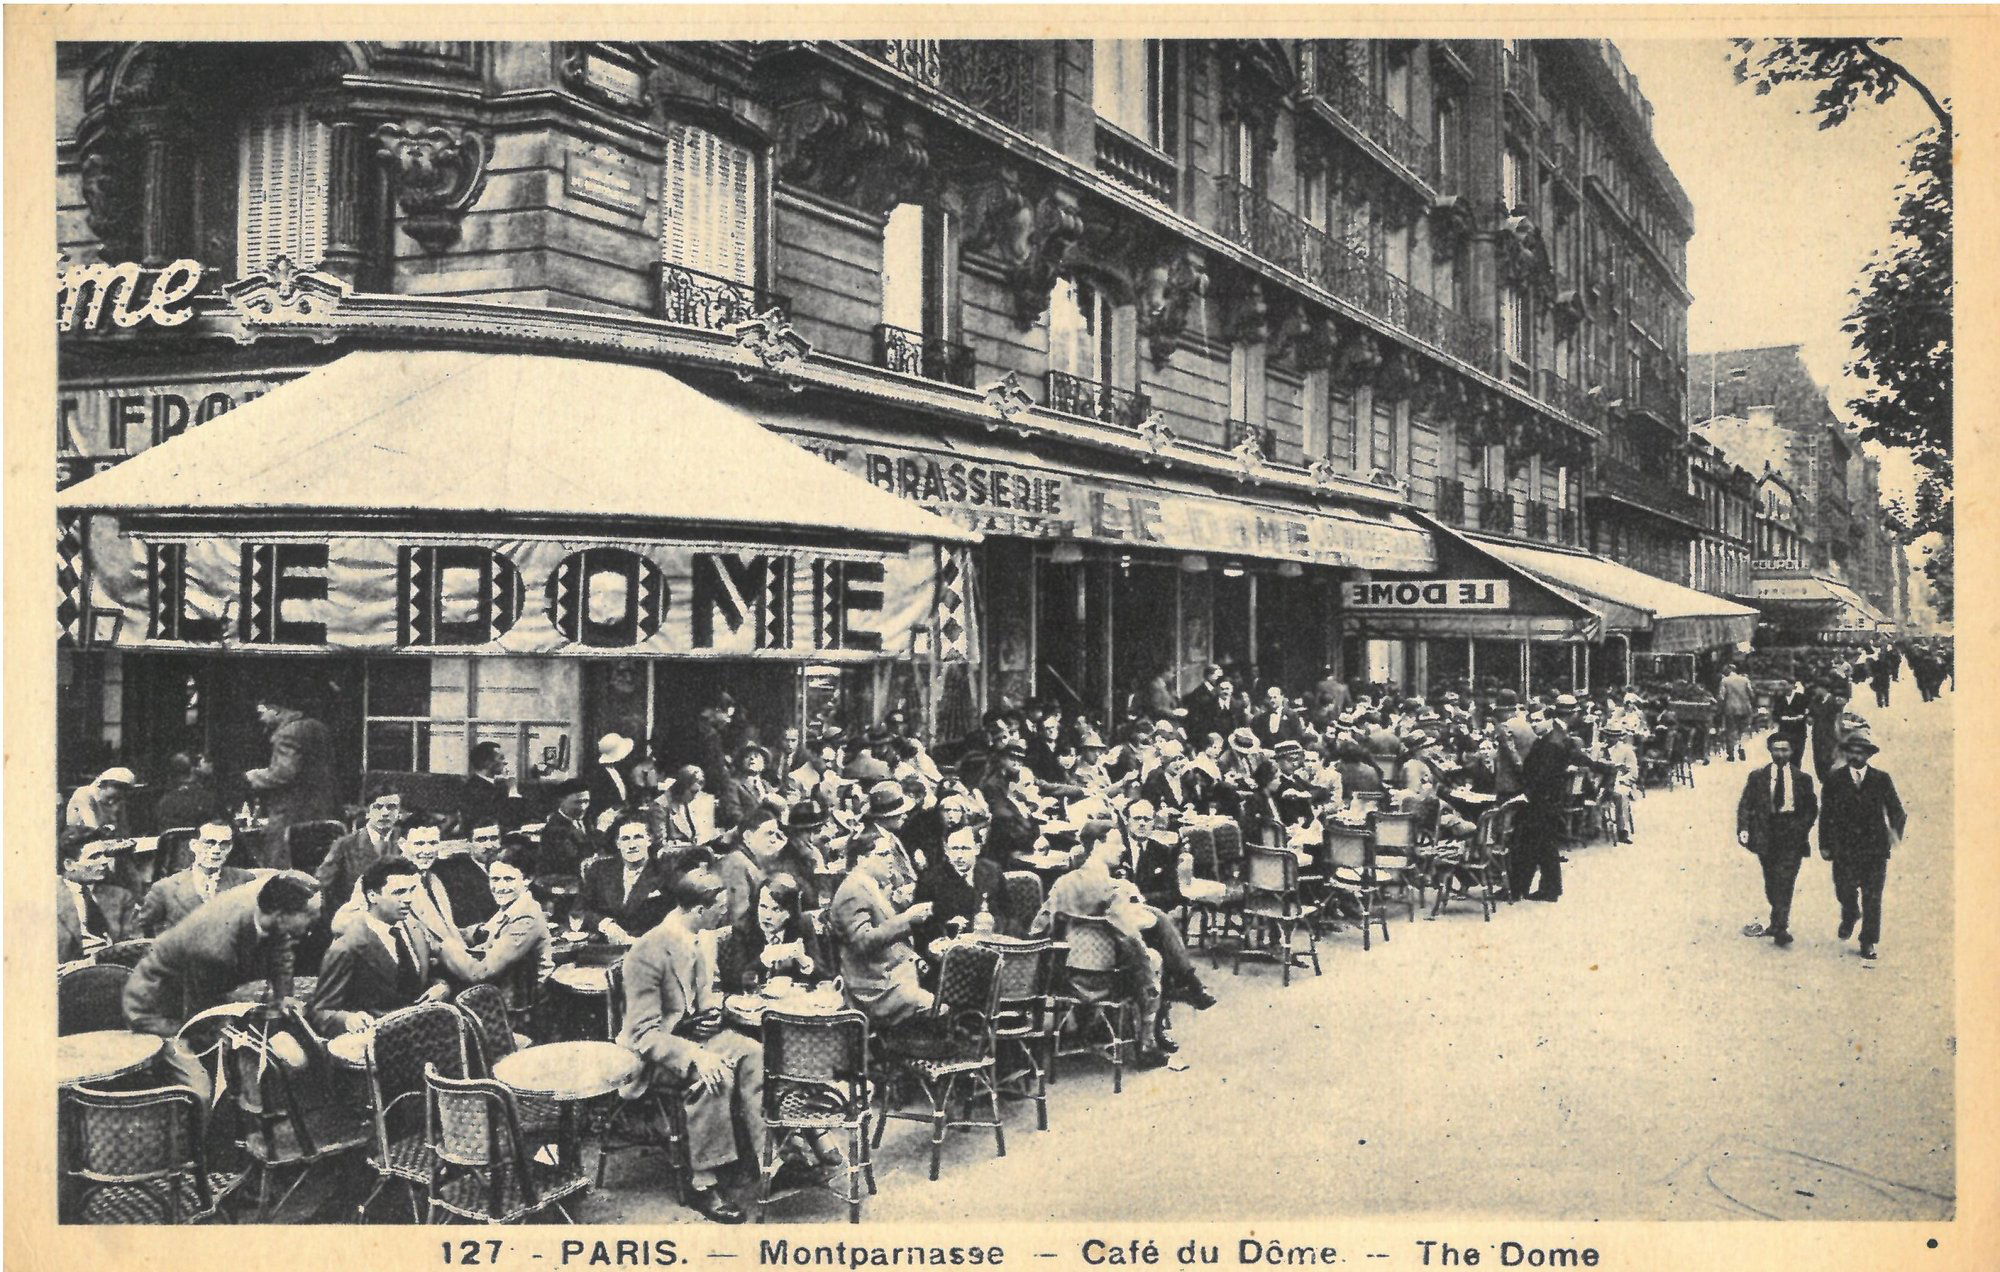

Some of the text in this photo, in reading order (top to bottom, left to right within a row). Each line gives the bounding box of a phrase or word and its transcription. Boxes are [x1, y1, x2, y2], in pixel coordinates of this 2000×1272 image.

[865, 453, 1062, 515] BRASSERIE
[146, 542, 885, 653] LE DOME
